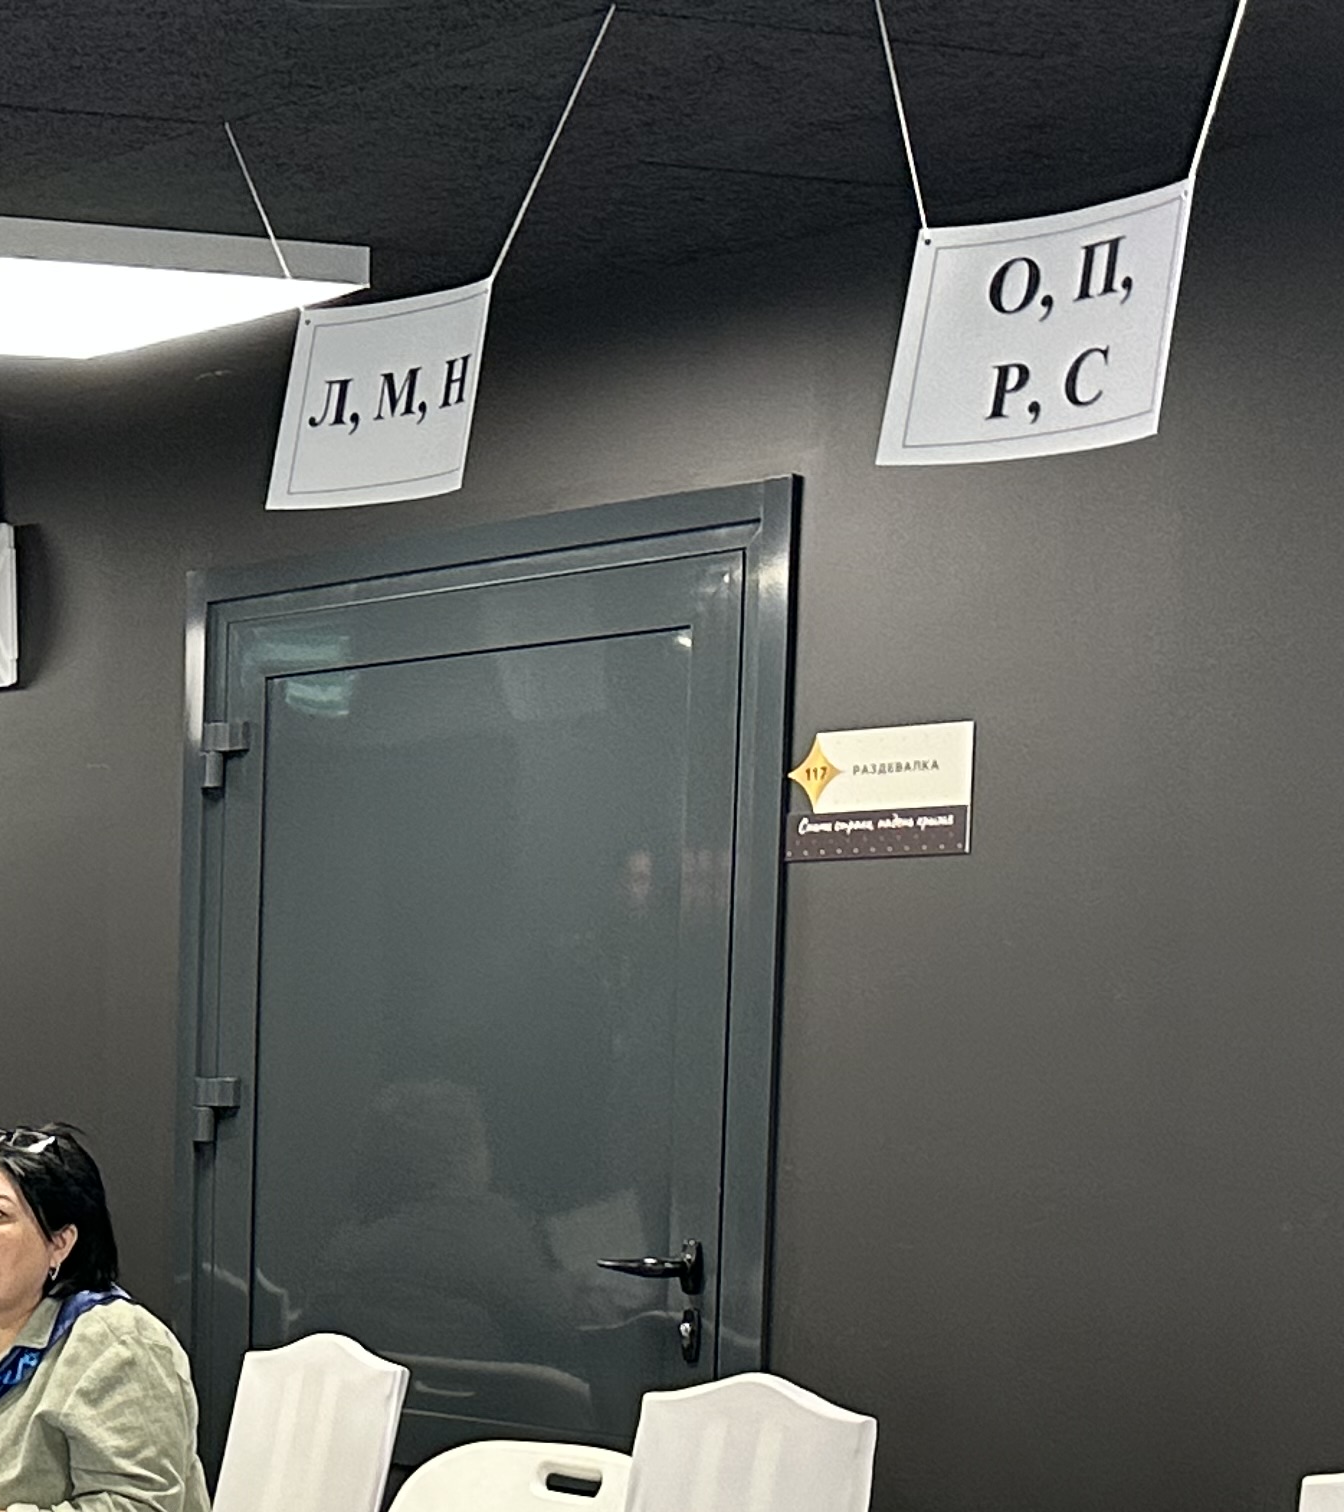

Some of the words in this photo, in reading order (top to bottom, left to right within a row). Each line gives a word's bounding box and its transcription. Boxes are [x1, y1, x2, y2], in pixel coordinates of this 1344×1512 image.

[988, 256, 1054, 322] О,
[1072, 234, 1133, 304] П,
[308, 377, 360, 436] Л,
[373, 366, 427, 425] М,
[438, 353, 473, 410] Н
[985, 362, 1041, 424] Р,
[1064, 344, 1110, 407] С
[804, 765, 829, 782] 117
[852, 759, 941, 776] РАЗДЕВАЛКА
